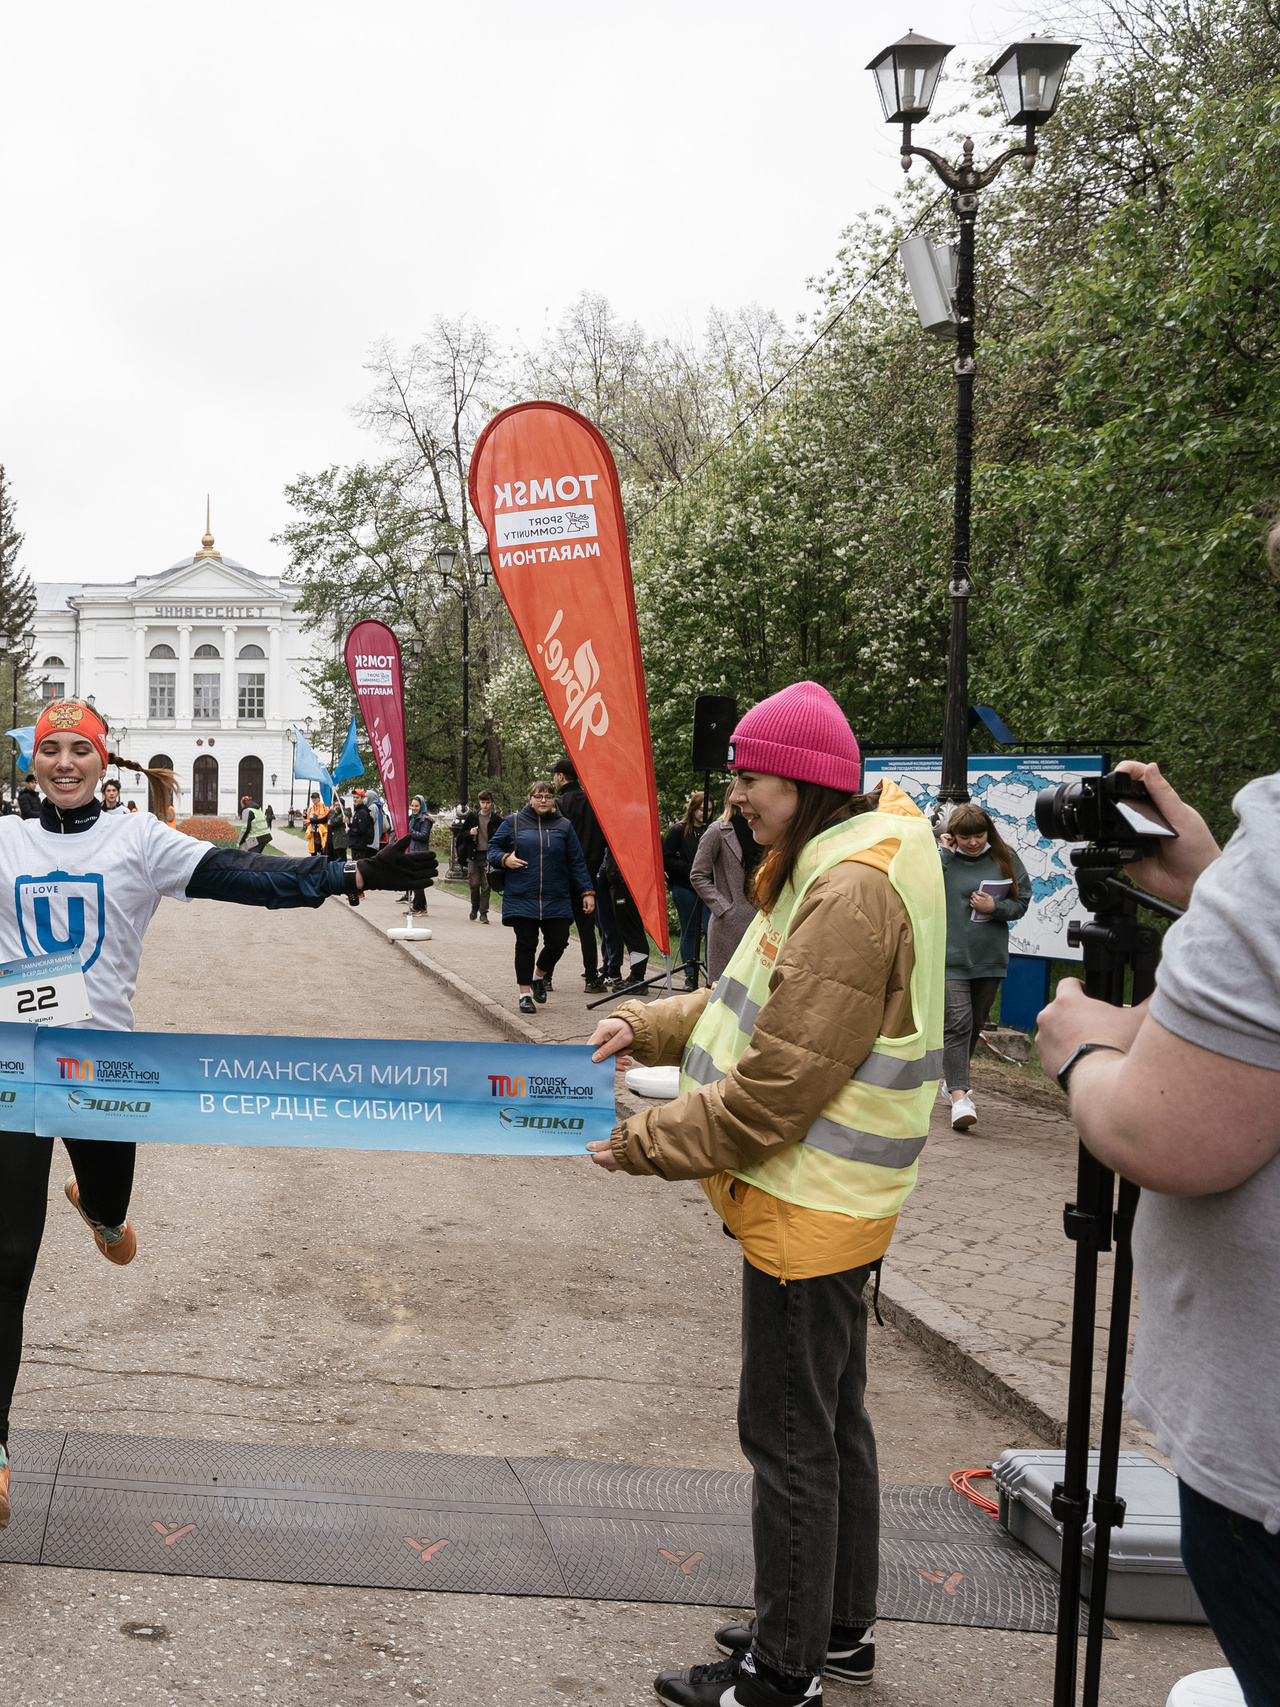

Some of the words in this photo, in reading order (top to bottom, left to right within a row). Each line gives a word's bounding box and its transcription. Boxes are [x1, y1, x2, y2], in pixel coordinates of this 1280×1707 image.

[155, 607, 265, 618] УНИВЕРСИТЕТ
[25, 887, 28, 895] I
[32, 885, 59, 894] LOVE
[21, 959, 54, 970] ТАМАНСКАЯ
[54, 955, 73, 964] МИЛЯ
[26, 968, 48, 977] СЕРДЦЕ
[48, 964, 73, 972] СИБИРИ
[16, 985, 59, 1014] 22
[96, 1060, 134, 1071] TOMSK
[97, 1069, 160, 1081] MARATHON
[199, 1058, 362, 1084] ТАМАНСКАЯ
[371, 1064, 448, 1087] МИЛЯ
[528, 1076, 567, 1086] TOMSK
[529, 1085, 593, 1096] MARATHON
[81, 1098, 151, 1113] ЭФКО
[200, 1094, 215, 1113] В
[223, 1095, 327, 1121] СЕРДЦЕ
[335, 1099, 442, 1122] СИБИРИ
[513, 1116, 585, 1130] ЭФКО
